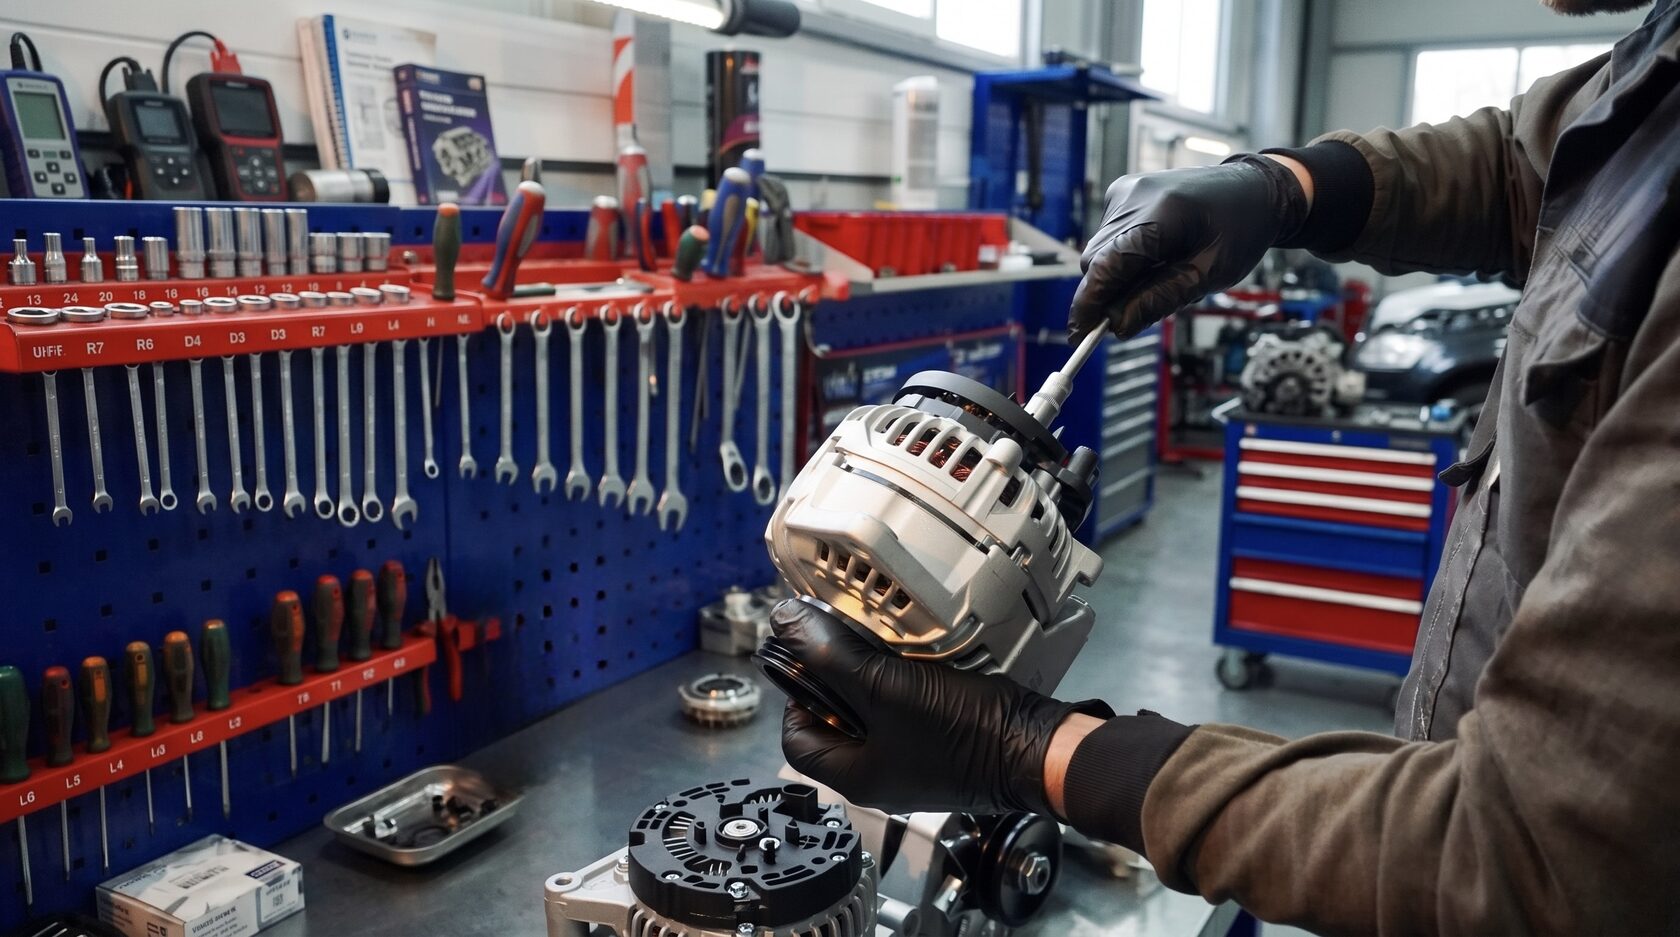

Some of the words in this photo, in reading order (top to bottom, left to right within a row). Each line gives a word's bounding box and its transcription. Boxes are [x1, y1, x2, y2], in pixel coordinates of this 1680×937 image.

[27, 294, 42, 305] 13
[63, 293, 79, 303] 24
[99, 291, 113, 302] 20
[133, 290, 146, 300] 18
[196, 287, 209, 297] 16
[226, 286, 238, 296] 14
[254, 284, 266, 295] 12
[281, 283, 293, 293] 12
[86, 341, 104, 354] R7
[136, 338, 154, 351] R6
[184, 335, 201, 347] D4
[229, 332, 246, 344] D3
[270, 328, 287, 340] D3
[312, 326, 325, 337] R7
[19, 791, 36, 806] L6
[65, 774, 81, 789] L5
[109, 759, 124, 774] L4
